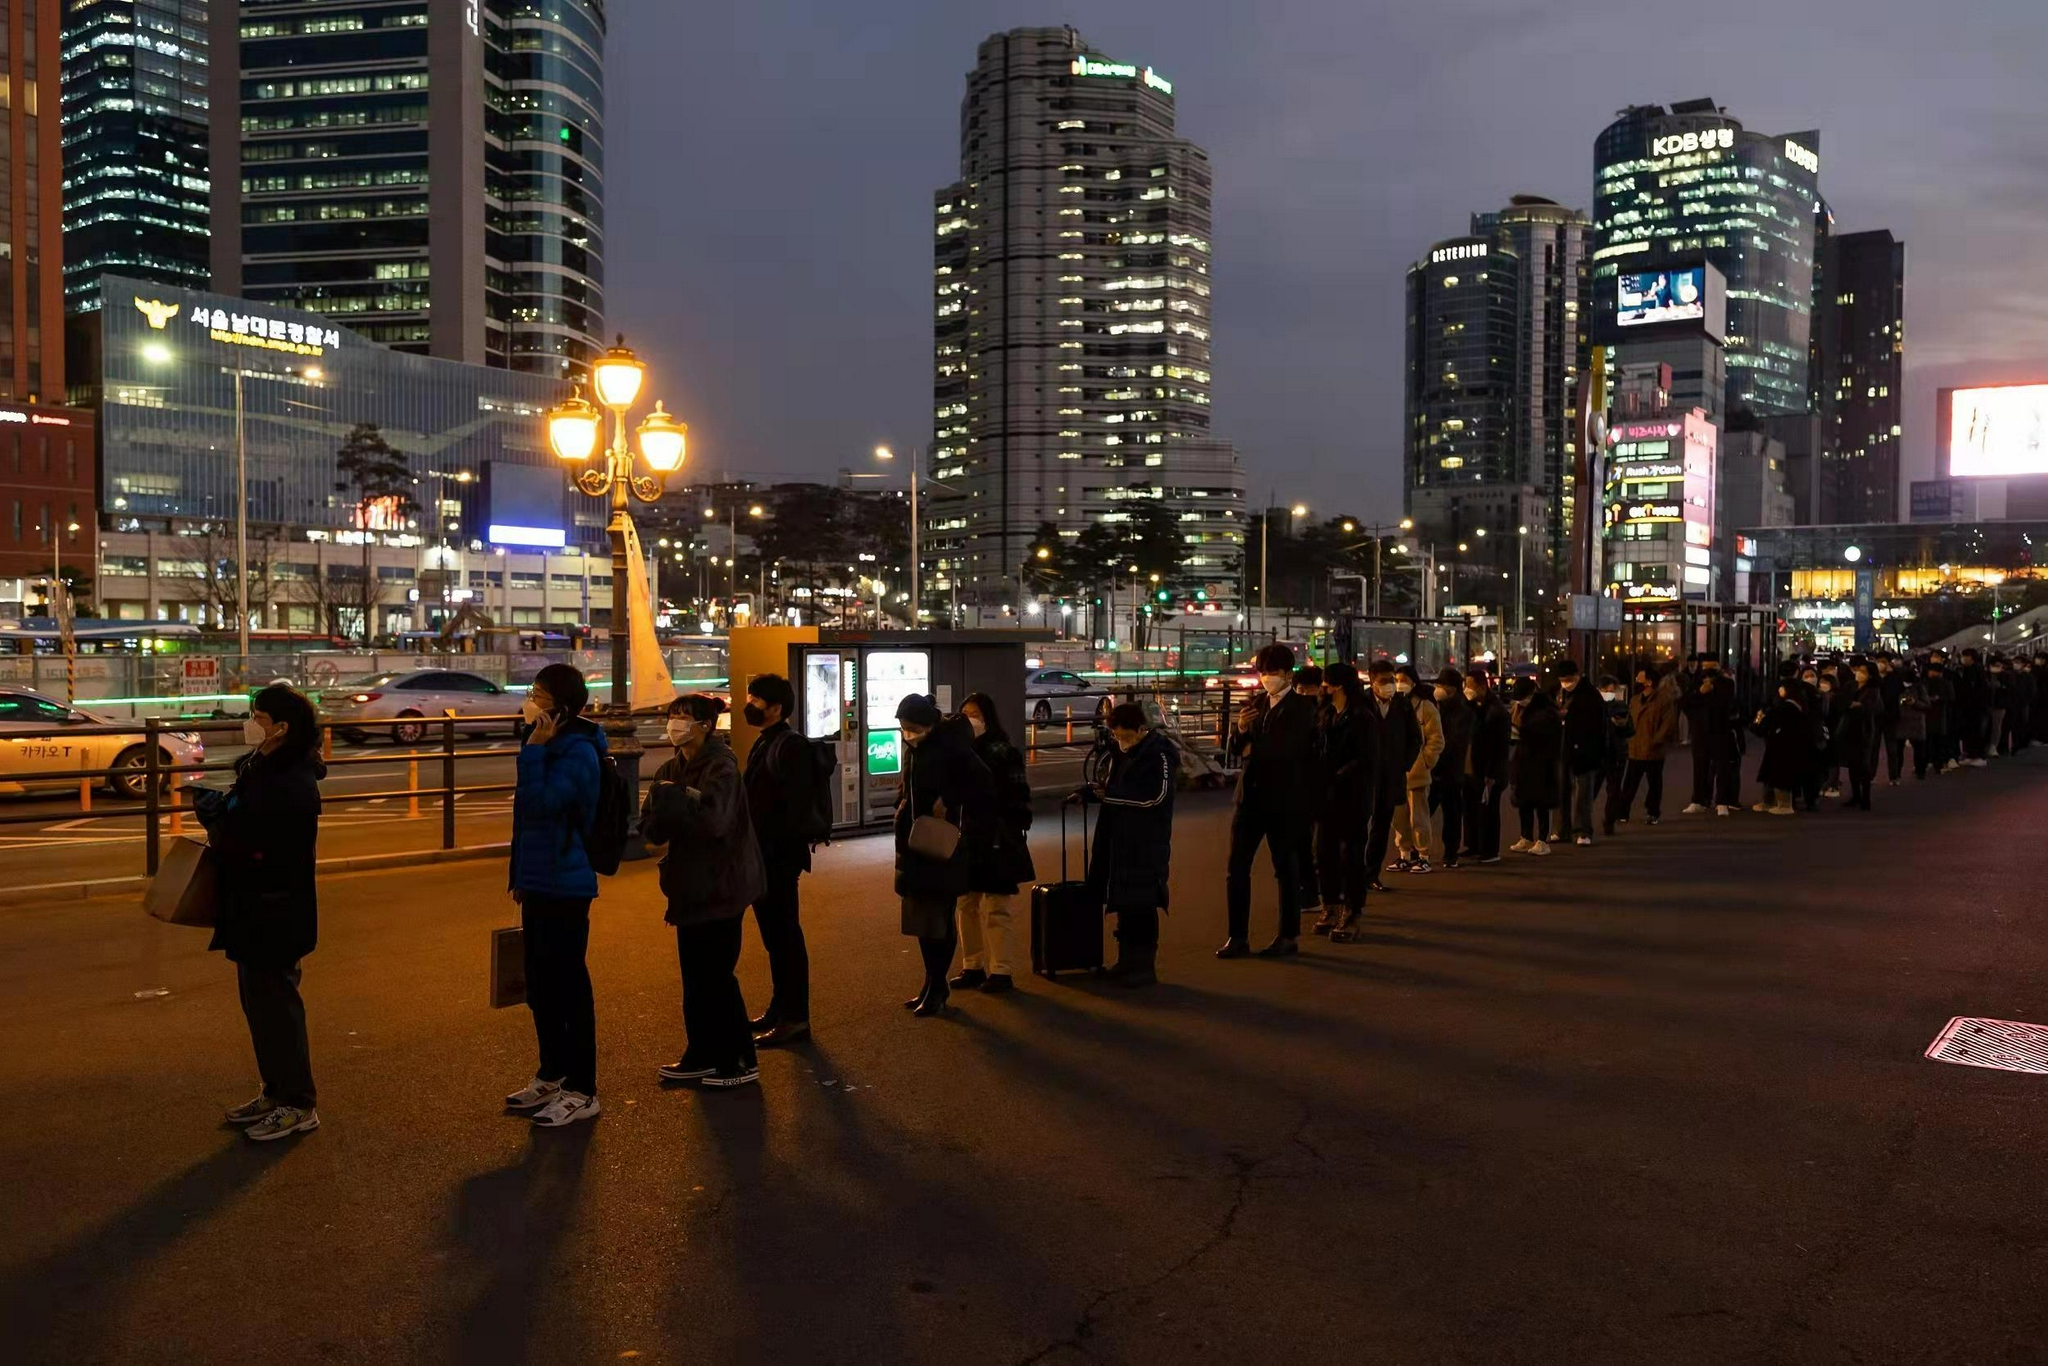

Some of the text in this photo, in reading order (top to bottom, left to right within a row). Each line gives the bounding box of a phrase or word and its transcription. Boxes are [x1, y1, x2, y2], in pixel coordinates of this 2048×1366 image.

[190, 306, 340, 349] 서울남대문경찰서
[20, 745, 72, 758] 카카오 T
